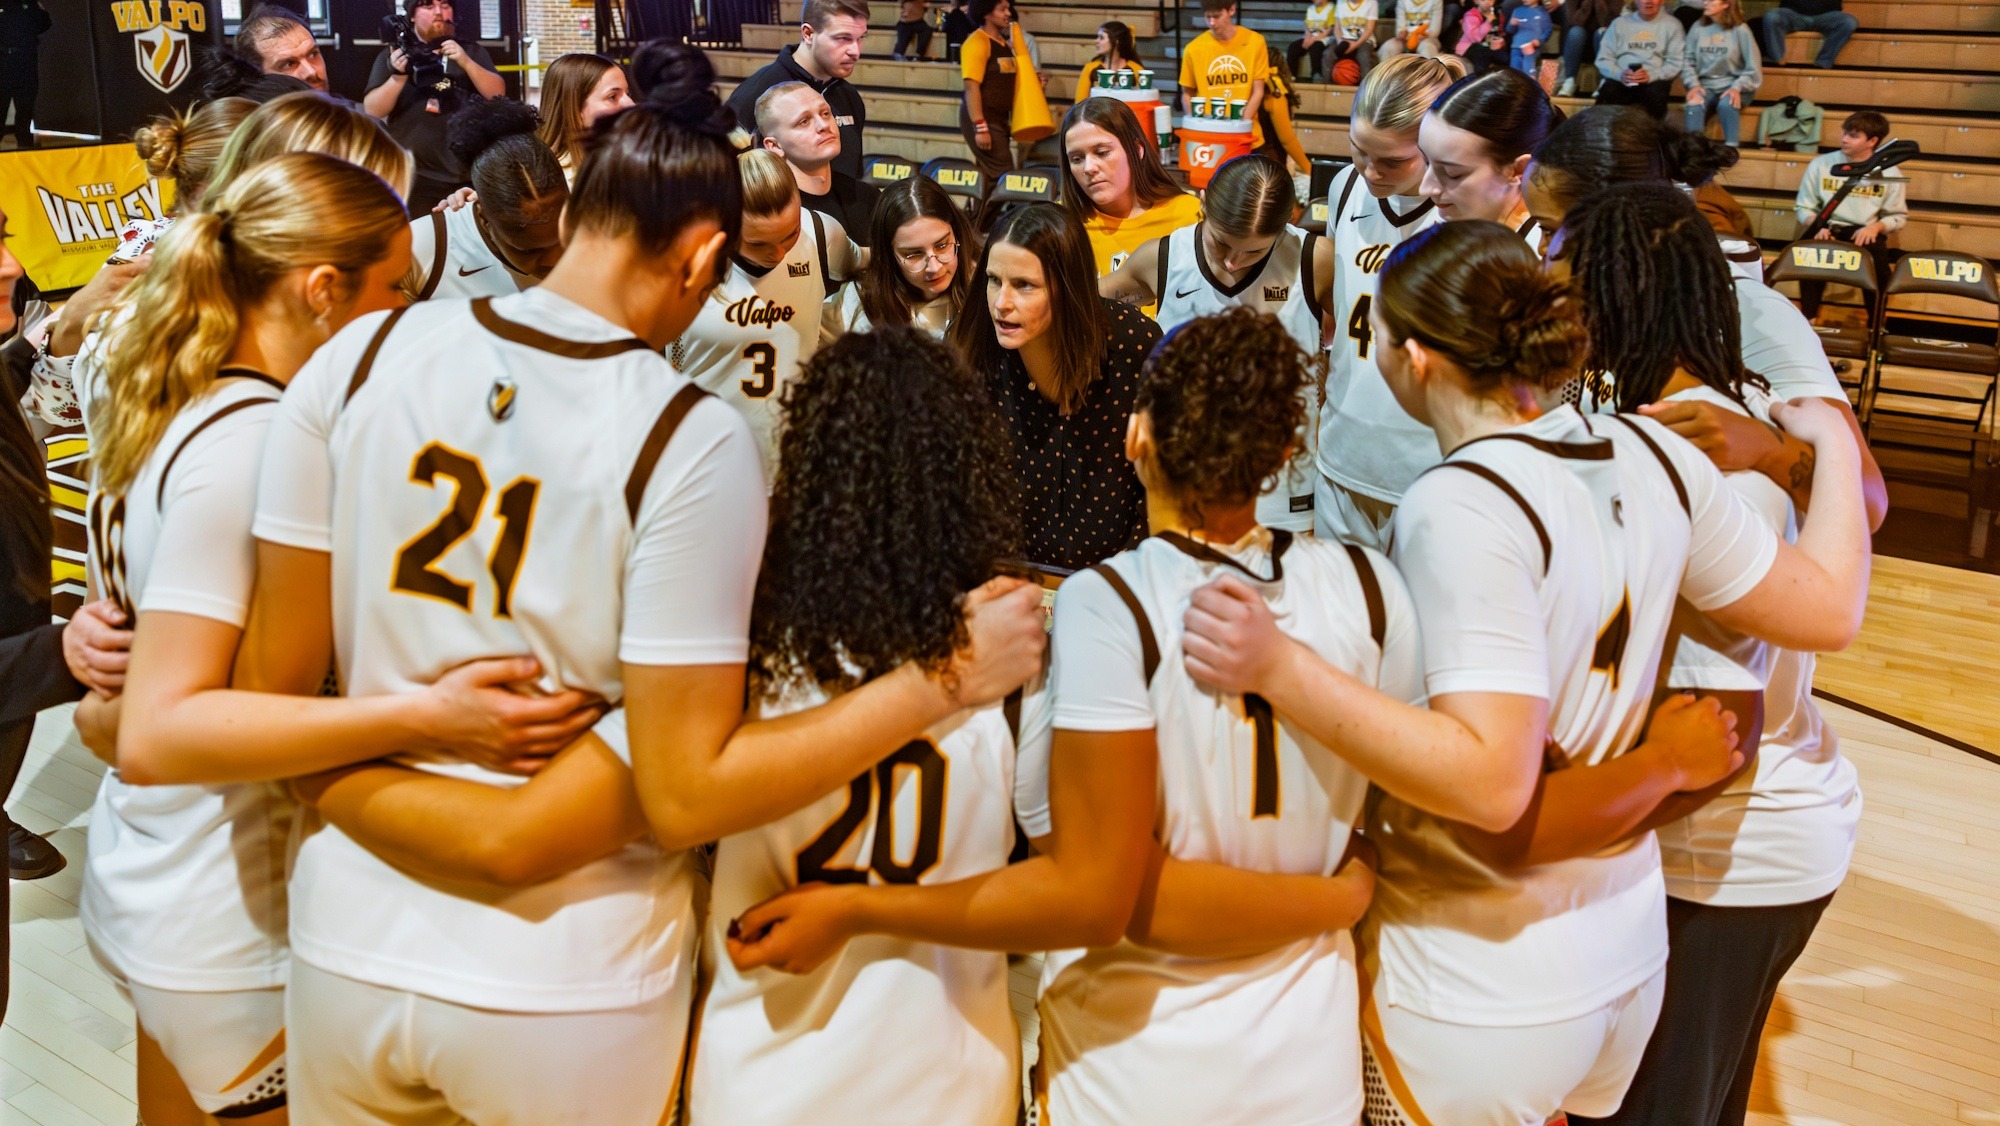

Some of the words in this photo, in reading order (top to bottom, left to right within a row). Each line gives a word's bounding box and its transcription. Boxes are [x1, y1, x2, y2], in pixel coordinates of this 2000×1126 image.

[111, 0, 206, 33] VALPO
[1206, 72, 1248, 86] VALPO
[1194, 145, 1210, 163] G
[872, 162, 911, 180] VALPO
[937, 168, 978, 187] VALPO
[76, 181, 117, 199] THE
[1005, 174, 1049, 194] VALPO
[36, 177, 165, 245] VALLEY
[786, 260, 810, 275] VALLEY
[1791, 246, 1862, 271] VALPO
[1908, 257, 1983, 284] VALPO
[1263, 286, 1289, 299] VALLEY
[724, 294, 796, 330] Valpo
[740, 341, 777, 400] 3
[388, 439, 542, 621] 21
[1240, 691, 1282, 820] 1
[792, 732, 950, 886] 20
